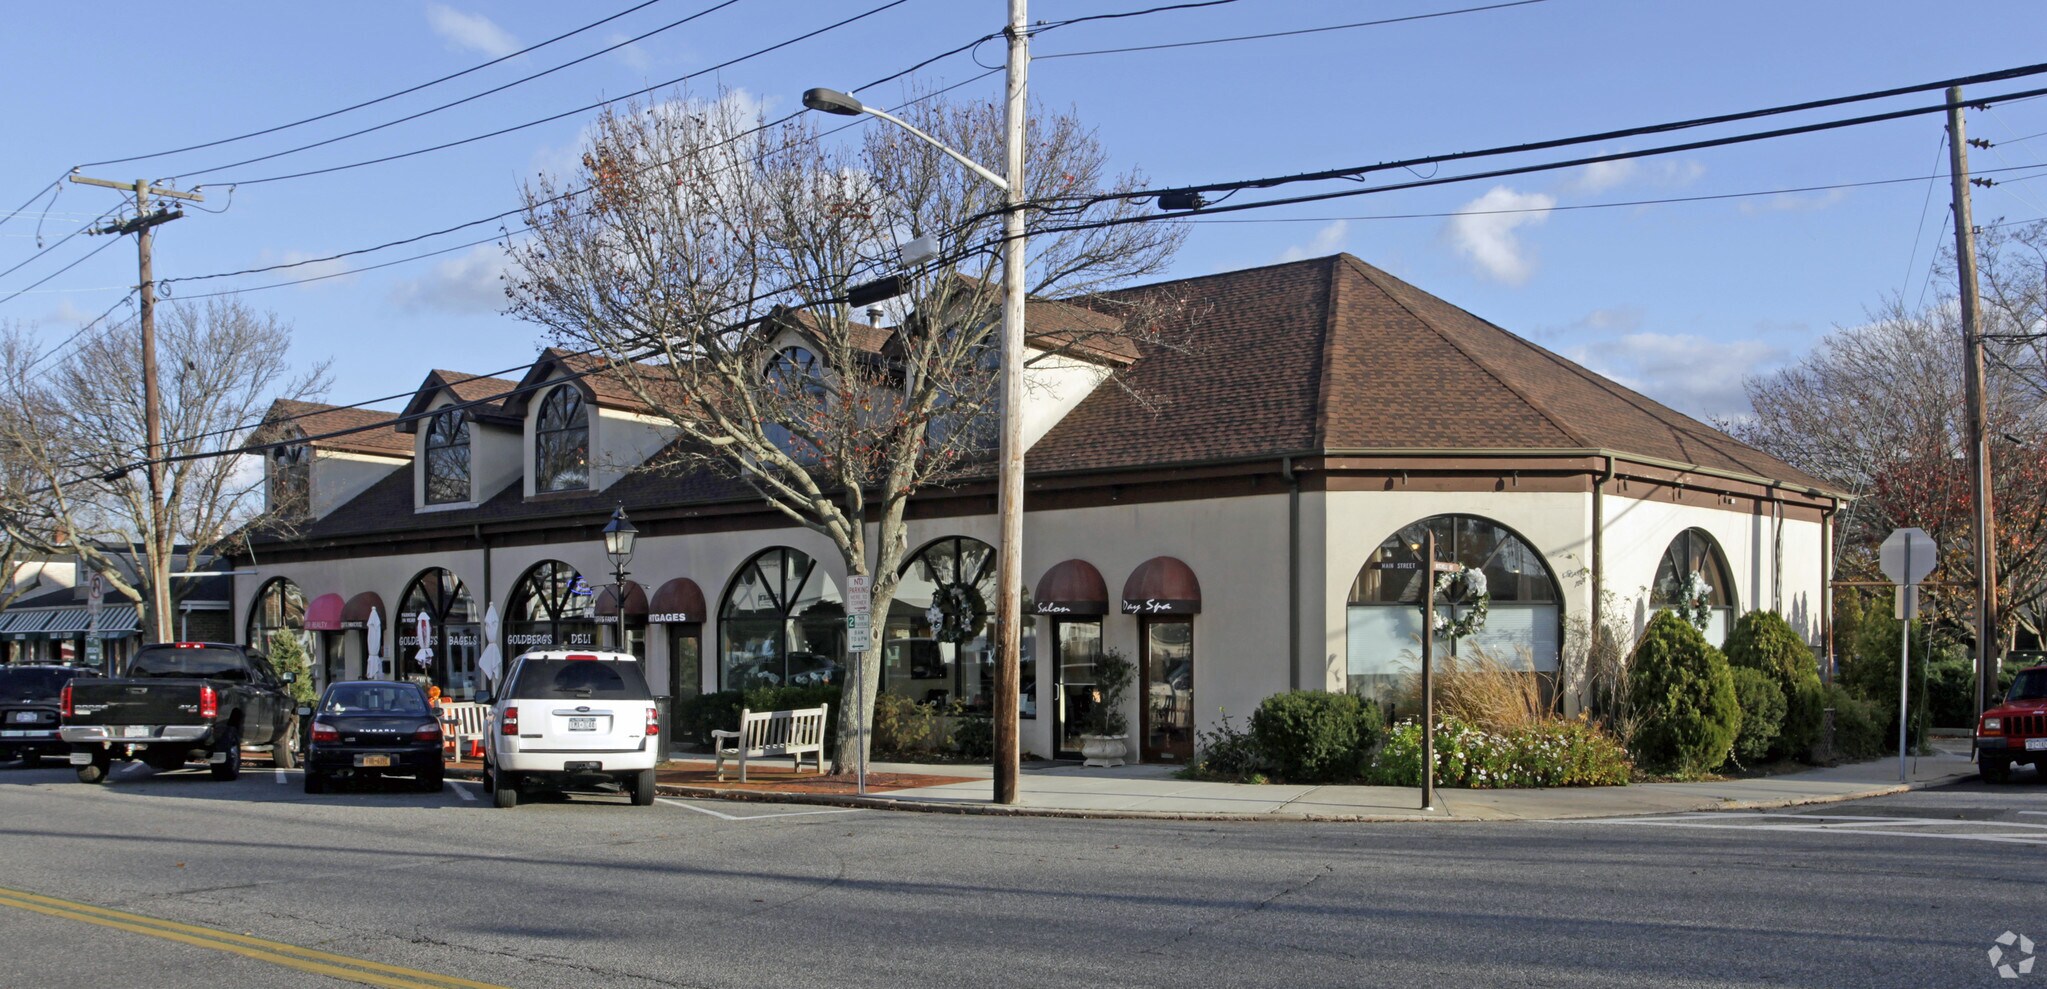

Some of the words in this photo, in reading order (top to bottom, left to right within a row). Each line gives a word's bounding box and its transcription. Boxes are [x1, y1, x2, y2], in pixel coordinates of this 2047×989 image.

[1037, 602, 1071, 613] Salon
[1122, 600, 1141, 614] Day
[1145, 598, 1172, 613] Spa
[850, 617, 854, 626] 2
[449, 636, 478, 646] BAGELS
[507, 634, 553, 645] GOLDBERG'S
[571, 633, 591, 644] DELI
